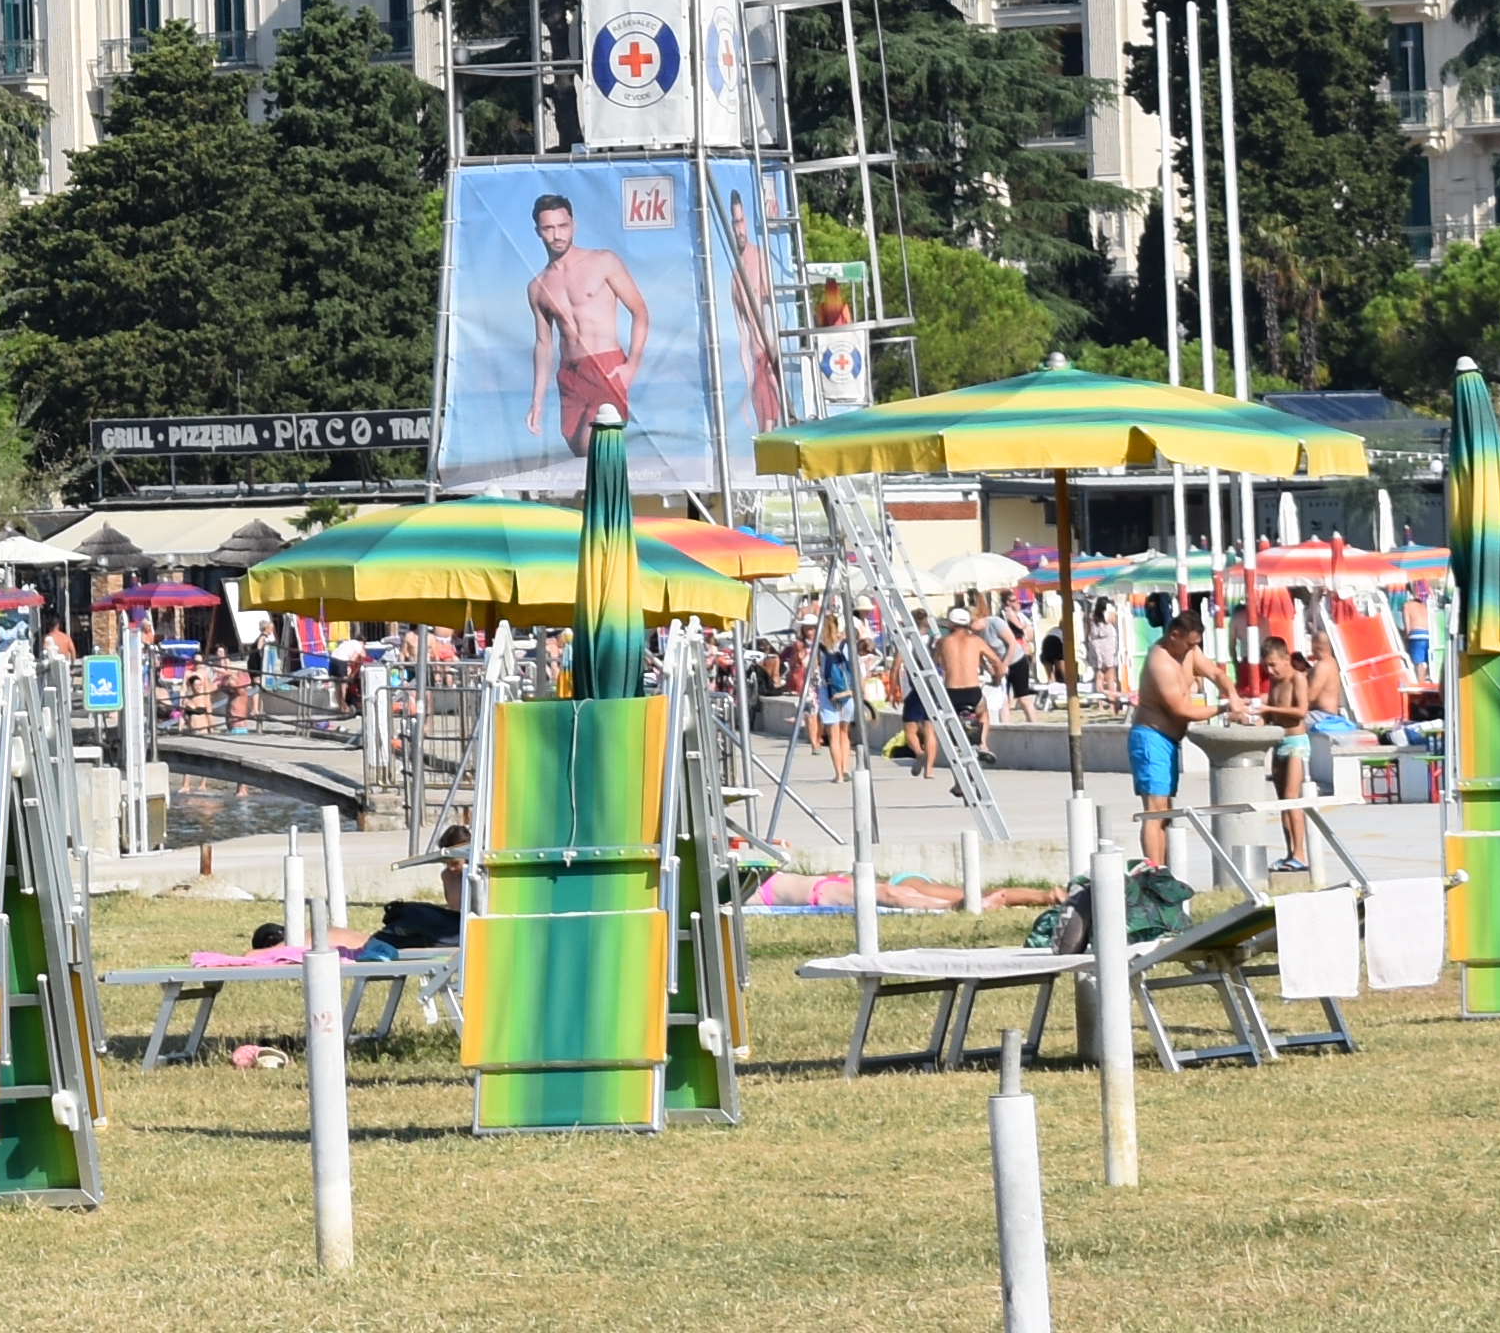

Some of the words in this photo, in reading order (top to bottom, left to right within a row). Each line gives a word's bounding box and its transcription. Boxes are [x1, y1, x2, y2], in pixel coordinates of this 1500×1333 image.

[630, 188, 668, 222] kik
[101, 427, 154, 448] GRILL
[168, 424, 258, 448] PIZZERIA
[272, 417, 373, 448] PACO
